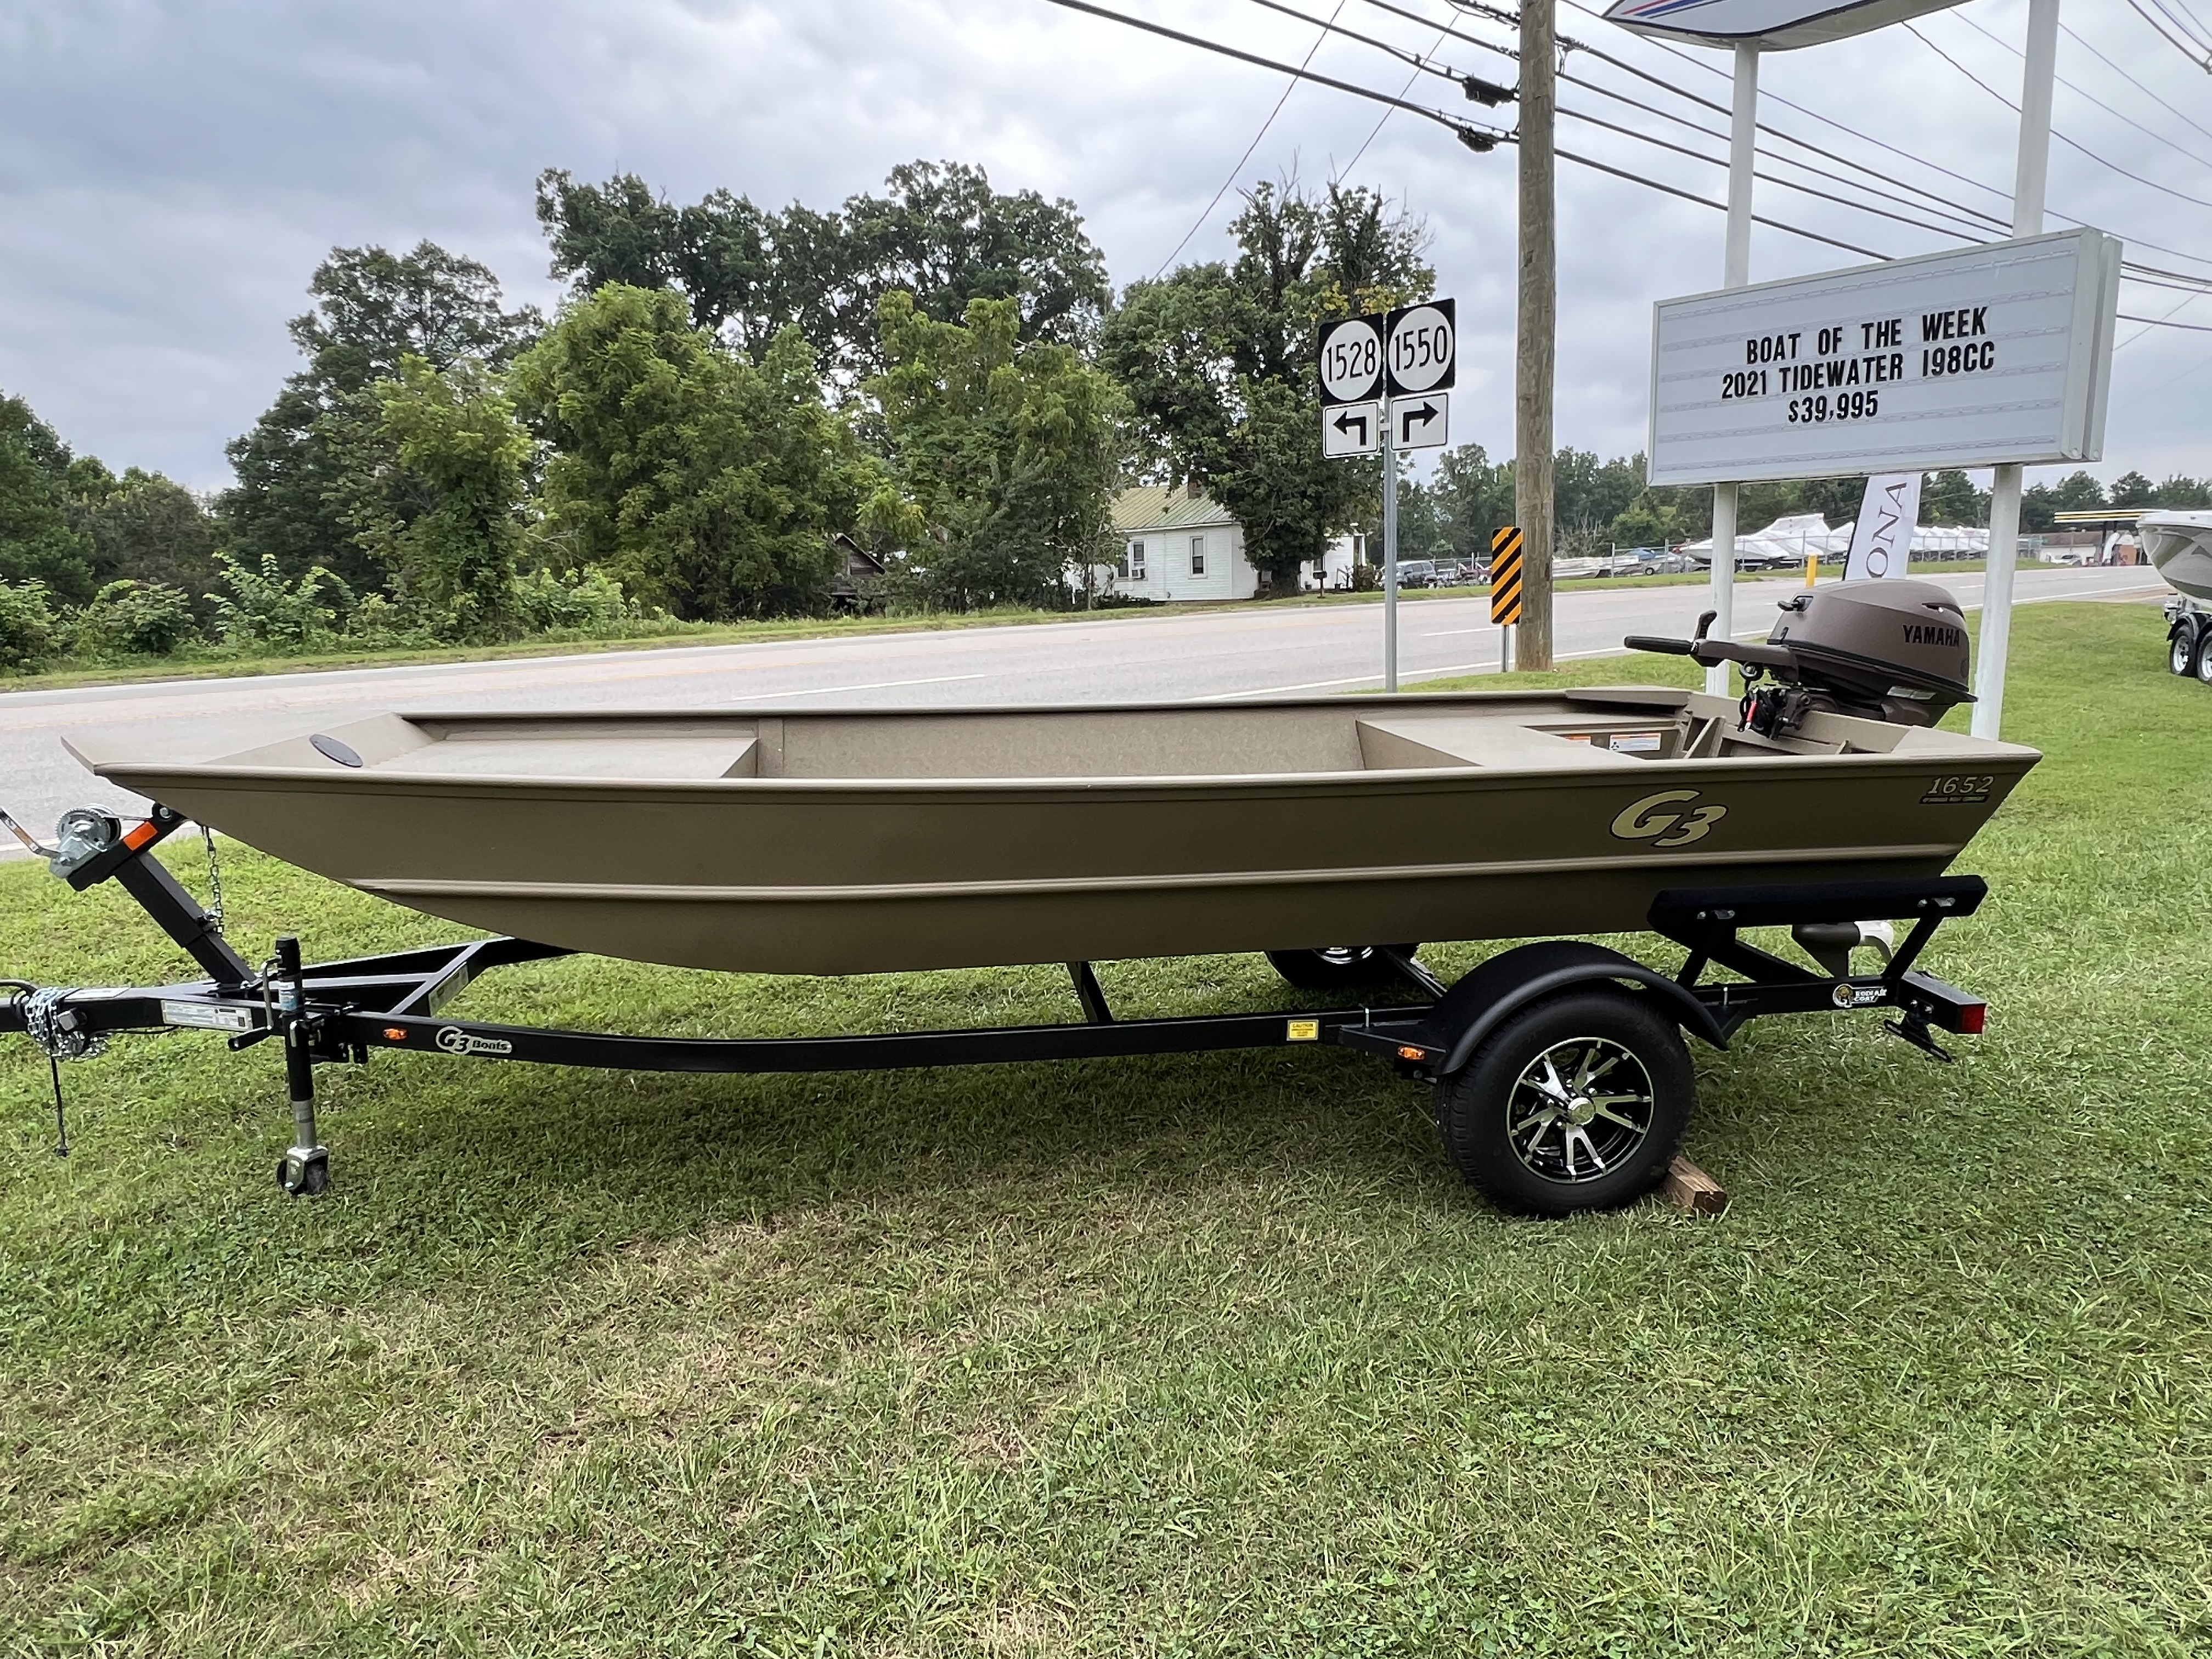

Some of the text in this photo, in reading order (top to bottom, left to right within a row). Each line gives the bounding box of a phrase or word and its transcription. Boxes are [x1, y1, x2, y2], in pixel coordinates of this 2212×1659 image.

[1395, 325, 1447, 371] 1550
[1747, 306, 1988, 365] BOAT OF THE WEEK
[1327, 338, 1376, 382] 1528
[1722, 370, 1767, 399] 2021
[1779, 353, 1904, 393] TIDEWATER
[1788, 390, 1878, 424] $39,995
[1903, 624, 1960, 648] YAMAHA
[1927, 776, 1994, 794] 1652
[1610, 788, 1729, 848] G3
[438, 1029, 508, 1053] G3 Boats
